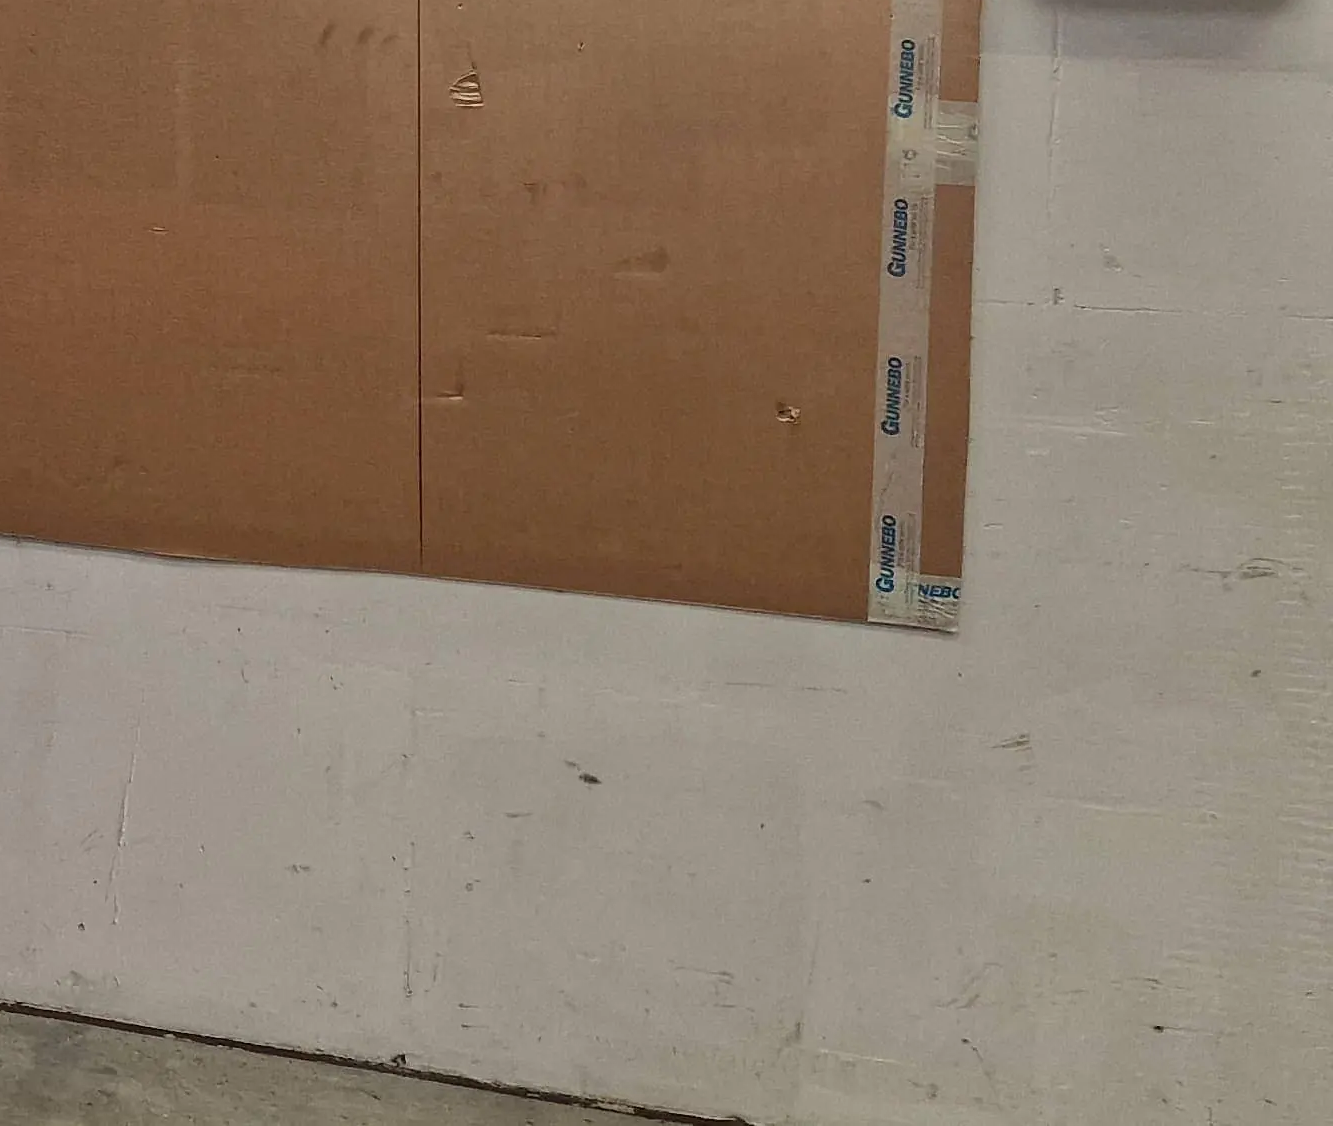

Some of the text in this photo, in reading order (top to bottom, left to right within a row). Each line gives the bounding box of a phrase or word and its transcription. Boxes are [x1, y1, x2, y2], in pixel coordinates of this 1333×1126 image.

[893, 39, 916, 119] GUNNEBO
[887, 198, 909, 278] GUNNEBO
[881, 357, 903, 435] GUNNEBO
[875, 514, 897, 593] GUNNEBO
